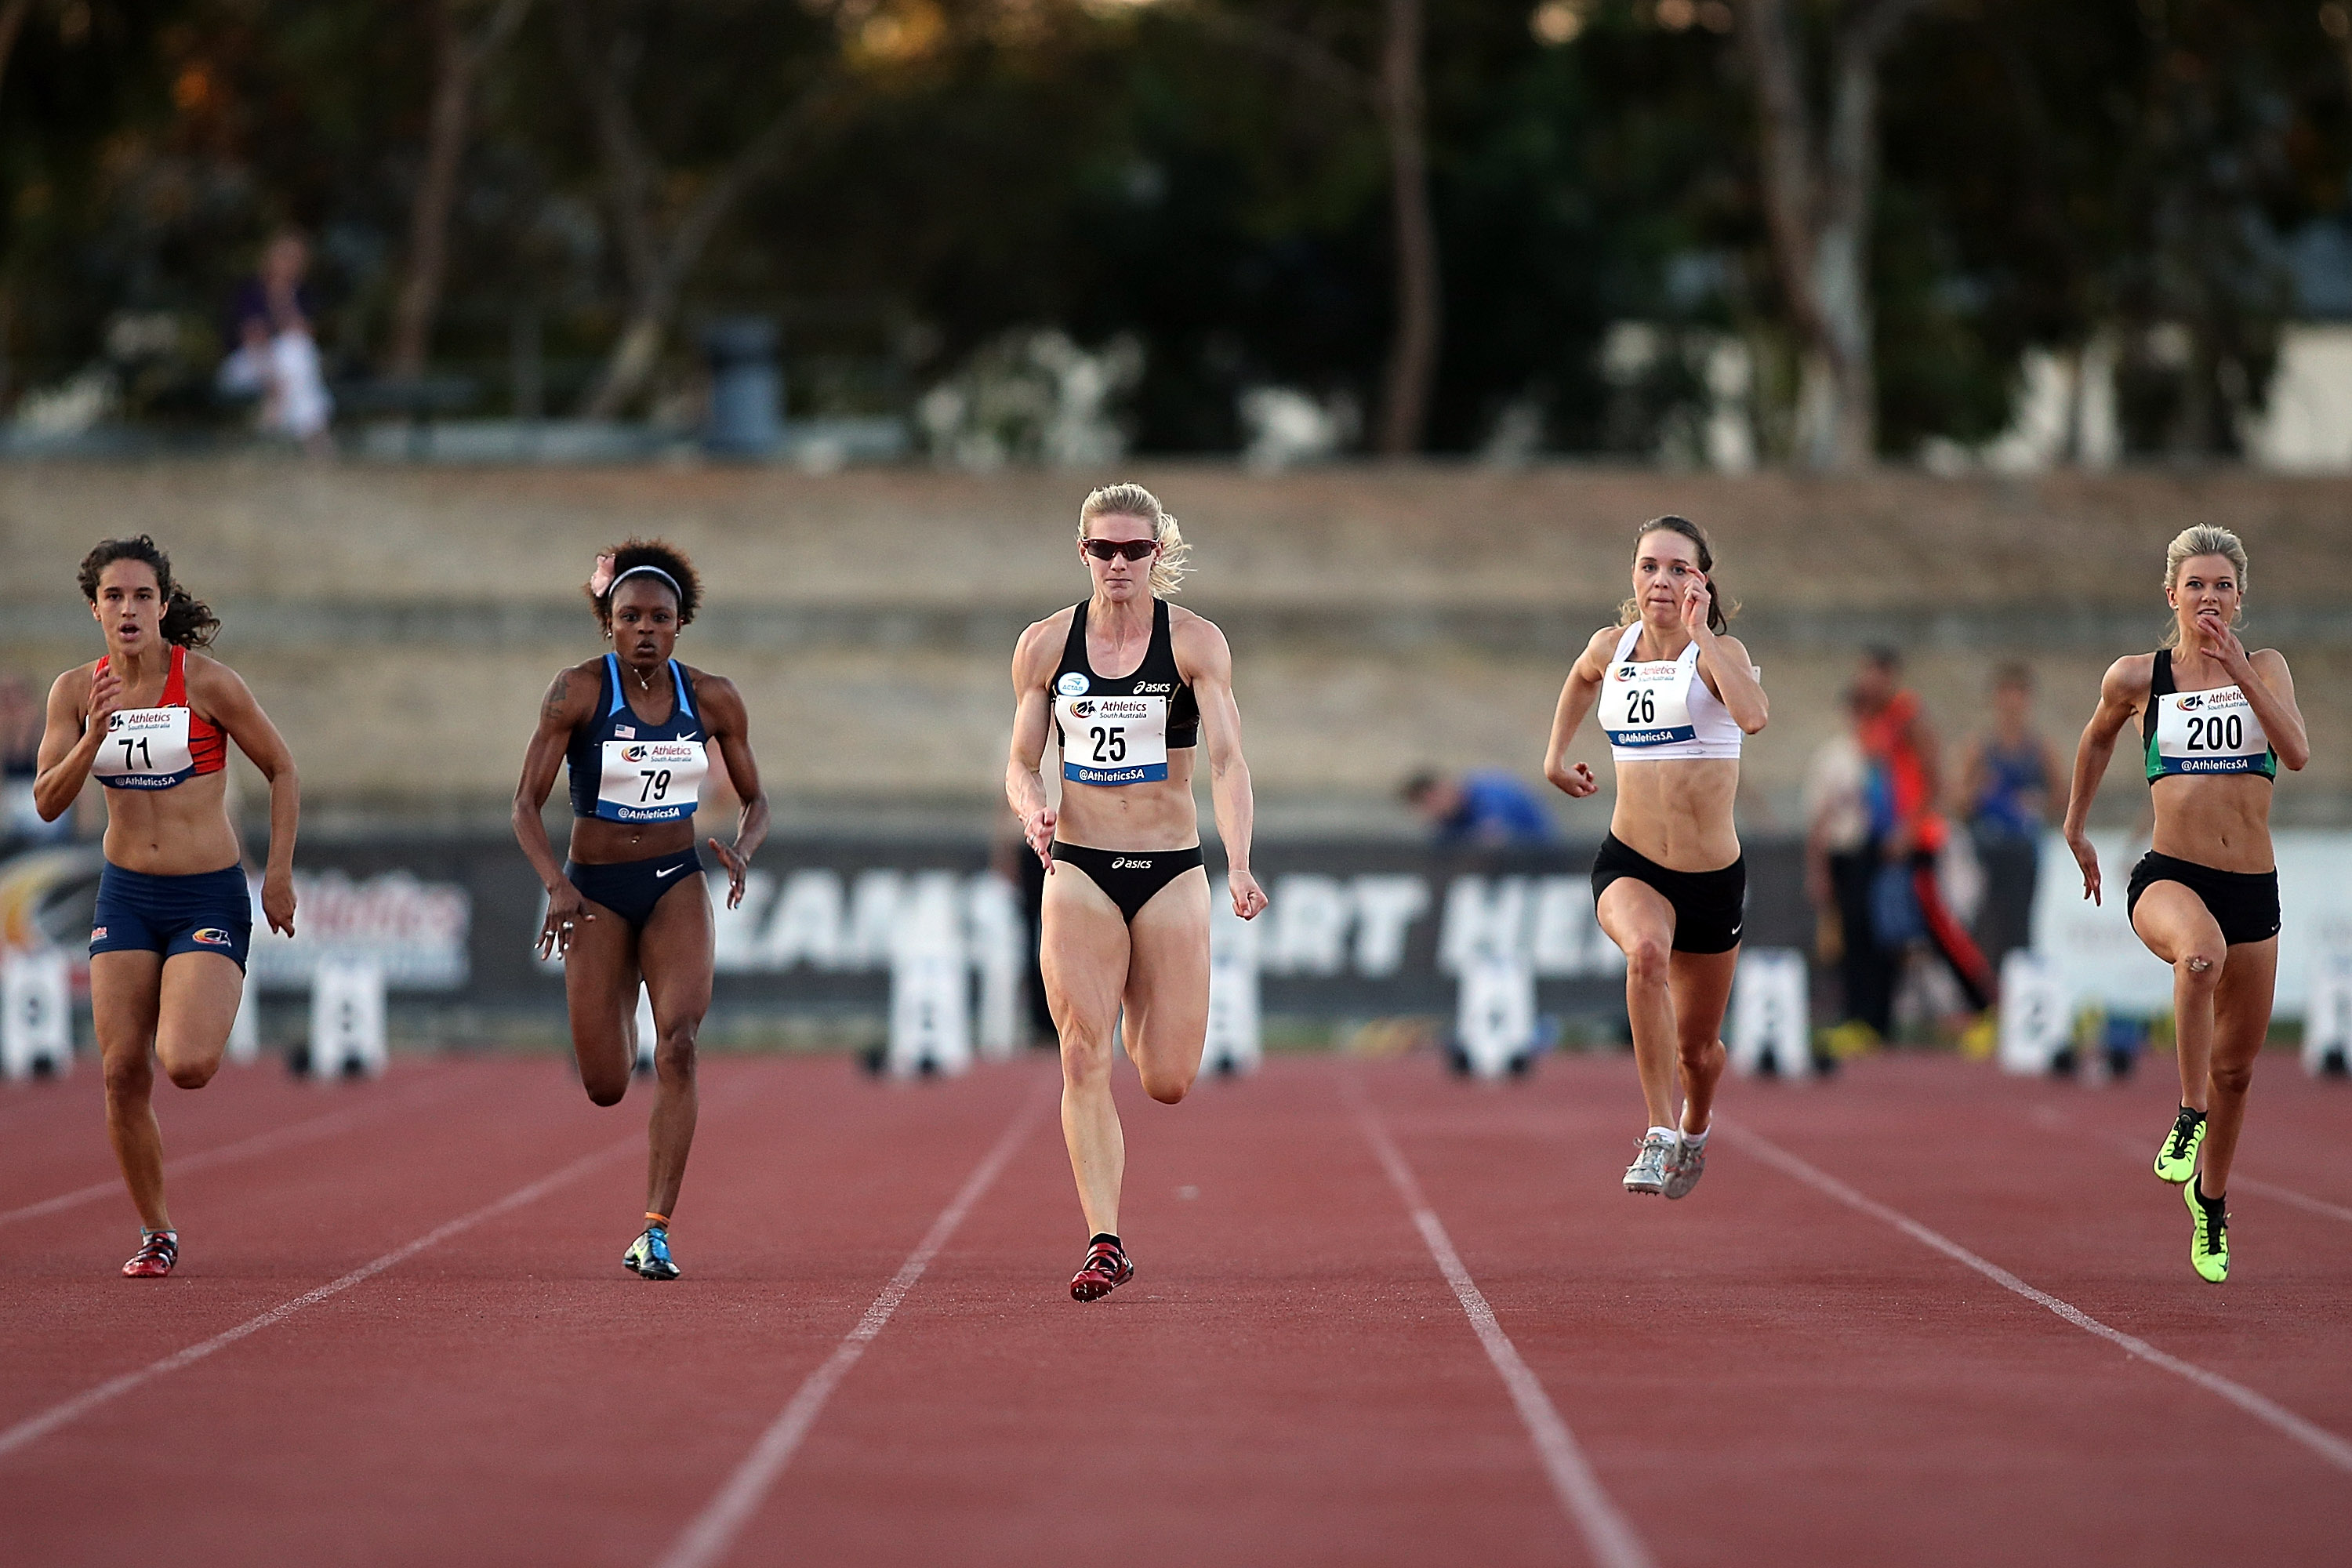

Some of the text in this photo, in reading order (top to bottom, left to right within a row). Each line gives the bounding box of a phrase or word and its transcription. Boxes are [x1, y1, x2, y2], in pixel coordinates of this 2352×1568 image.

[1145, 683, 1171, 692] asics
[2209, 690, 2245, 703] Athletic
[1101, 701, 1147, 711] Athletics
[1627, 689, 1654, 723] 26
[129, 712, 171, 724] Athletics
[1618, 731, 1674, 743] @AthleticsSA
[2187, 714, 2243, 750] 200
[652, 745, 691, 755] Athletics
[1090, 726, 1126, 762] 25
[118, 736, 153, 770] 71
[2181, 759, 2248, 771] @AthleticsSA
[115, 776, 176, 786] @AthleticsSA
[1079, 769, 1145, 782] @AthleticsSA
[640, 769, 671, 802] 79
[618, 808, 681, 819] @AthleticsSA
[1124, 860, 1152, 869] asics
